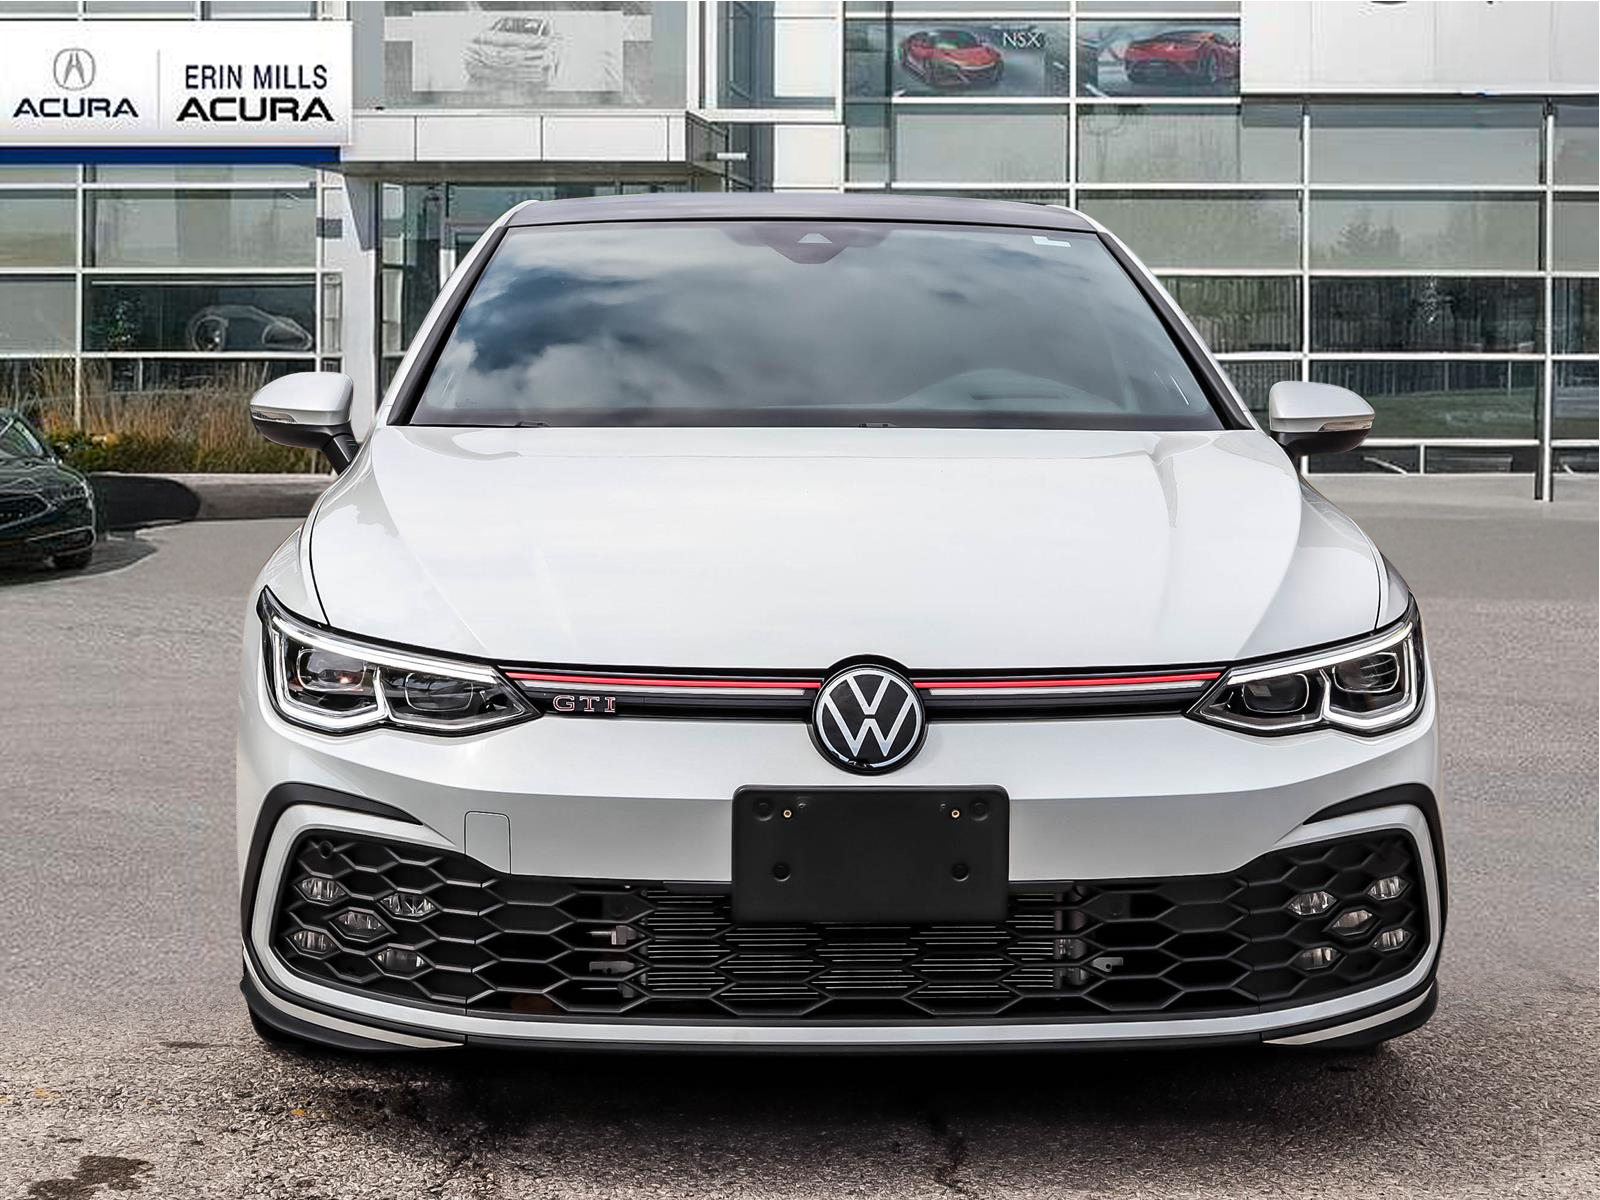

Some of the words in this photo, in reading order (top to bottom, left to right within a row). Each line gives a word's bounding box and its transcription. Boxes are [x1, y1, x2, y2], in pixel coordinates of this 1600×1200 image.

[1003, 32, 1041, 48] NSX
[186, 65, 242, 89] ERIN
[253, 65, 328, 89] MILLS
[13, 98, 139, 117] ACURA
[176, 97, 335, 121] ACURA
[553, 695, 616, 712] GTI
